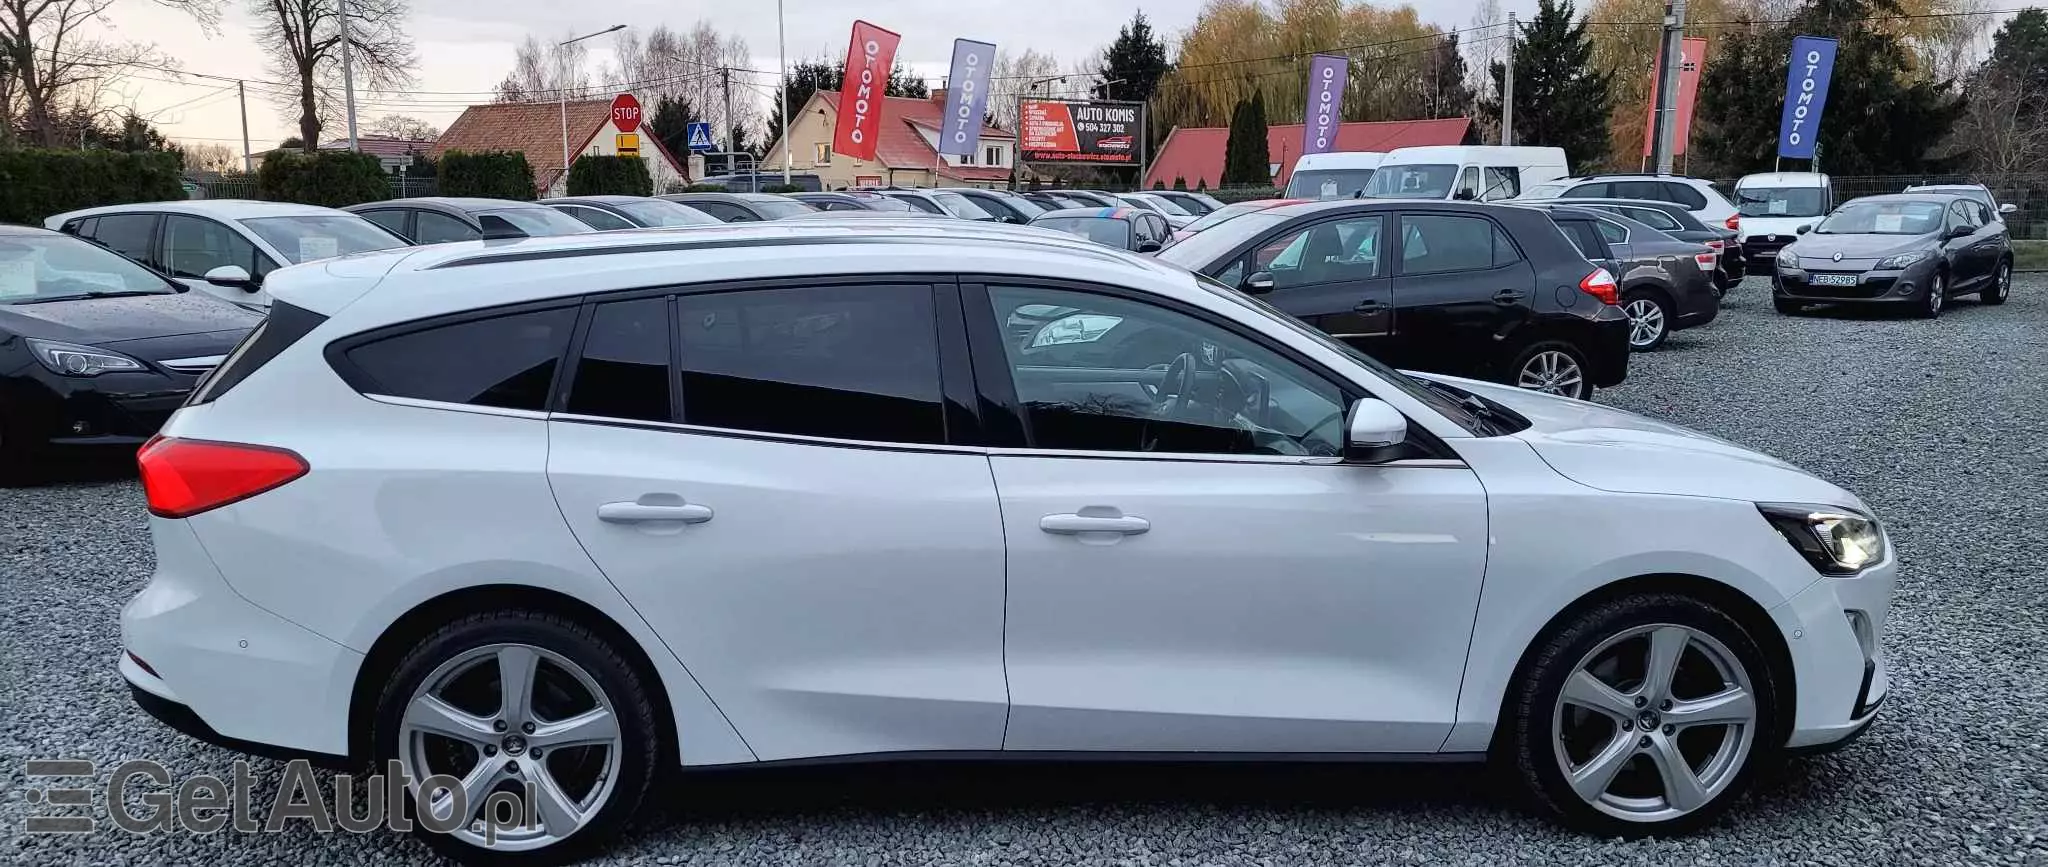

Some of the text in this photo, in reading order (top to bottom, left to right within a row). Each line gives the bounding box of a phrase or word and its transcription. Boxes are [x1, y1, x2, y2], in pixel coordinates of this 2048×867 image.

[614, 107, 639, 120] STOP
[851, 40, 879, 144] OTOMOTO
[955, 53, 979, 143] OTOMOTO
[1077, 107, 1135, 122] AUTO KOMIS
[1316, 67, 1334, 149] OTOMOTO
[1789, 50, 1820, 145] OTOMOTO
[1085, 122, 1125, 133] 504 327 302
[1831, 275, 1856, 285] 52985
